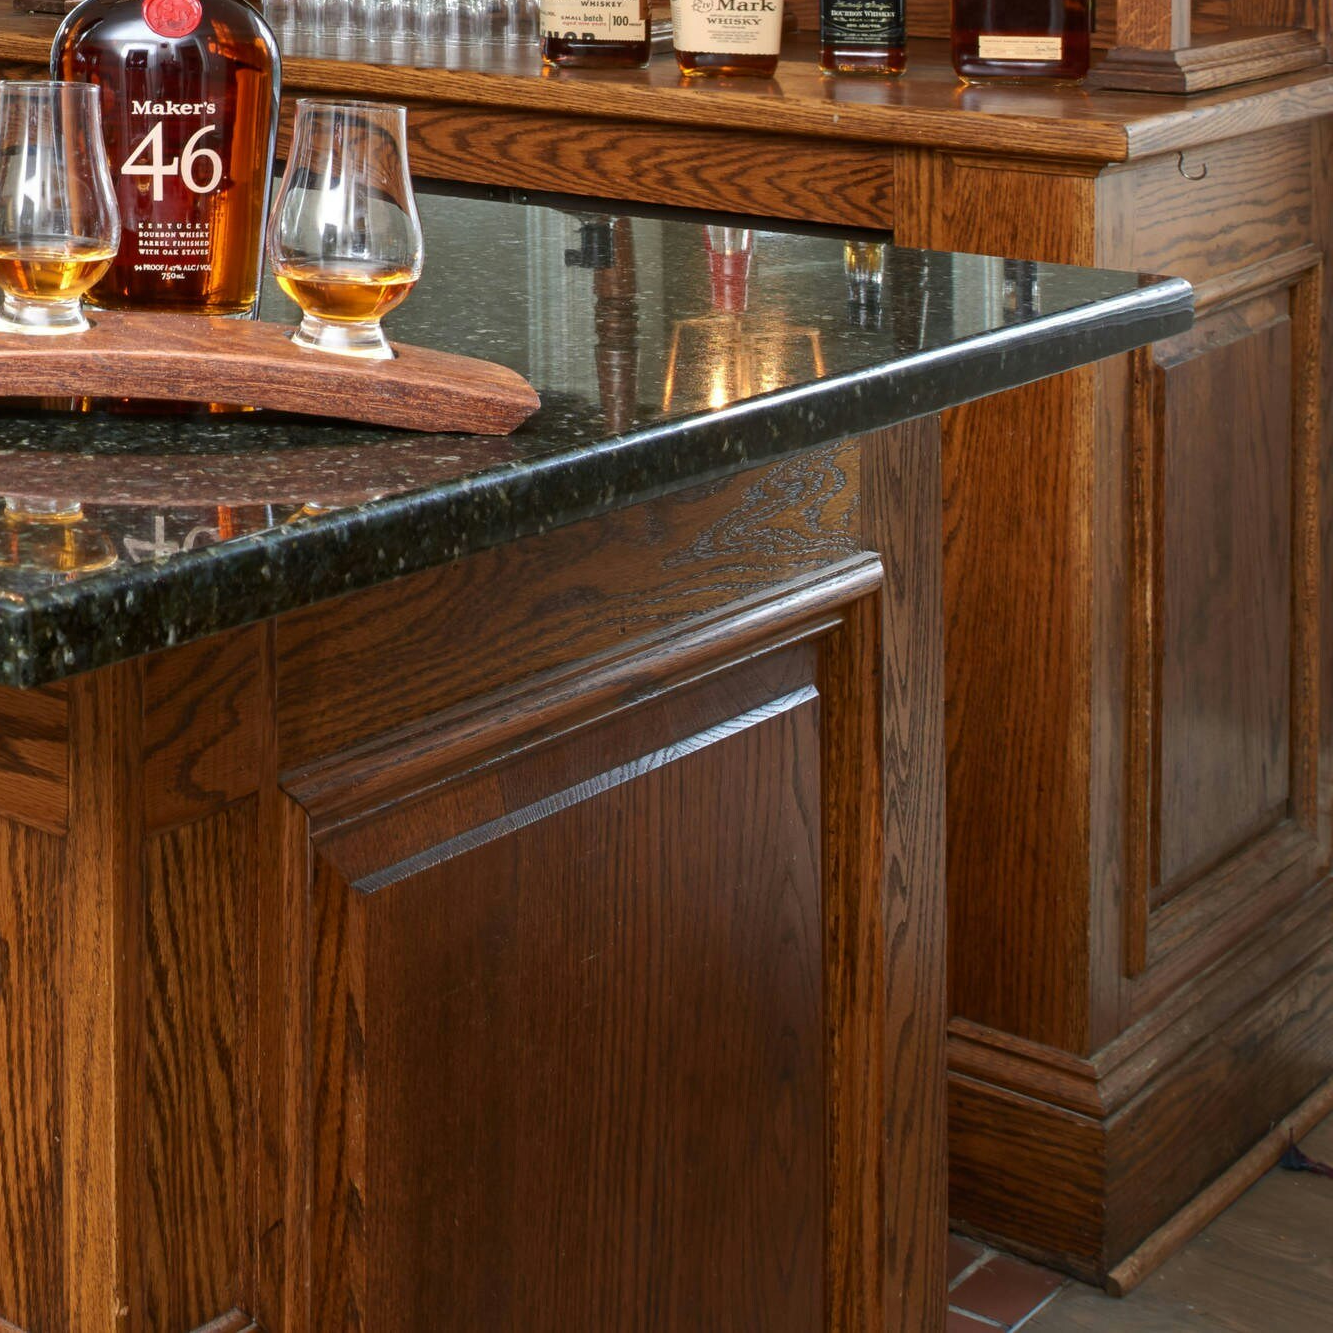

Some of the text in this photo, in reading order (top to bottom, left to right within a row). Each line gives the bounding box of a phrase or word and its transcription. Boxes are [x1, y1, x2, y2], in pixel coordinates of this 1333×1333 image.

[581, 0, 622, 8] WHISKEY
[583, 13, 603, 22] batch
[613, 16, 629, 26] 100
[706, 17, 762, 26] WHISKY
[132, 100, 216, 115] Maker's
[121, 121, 223, 201] 46
